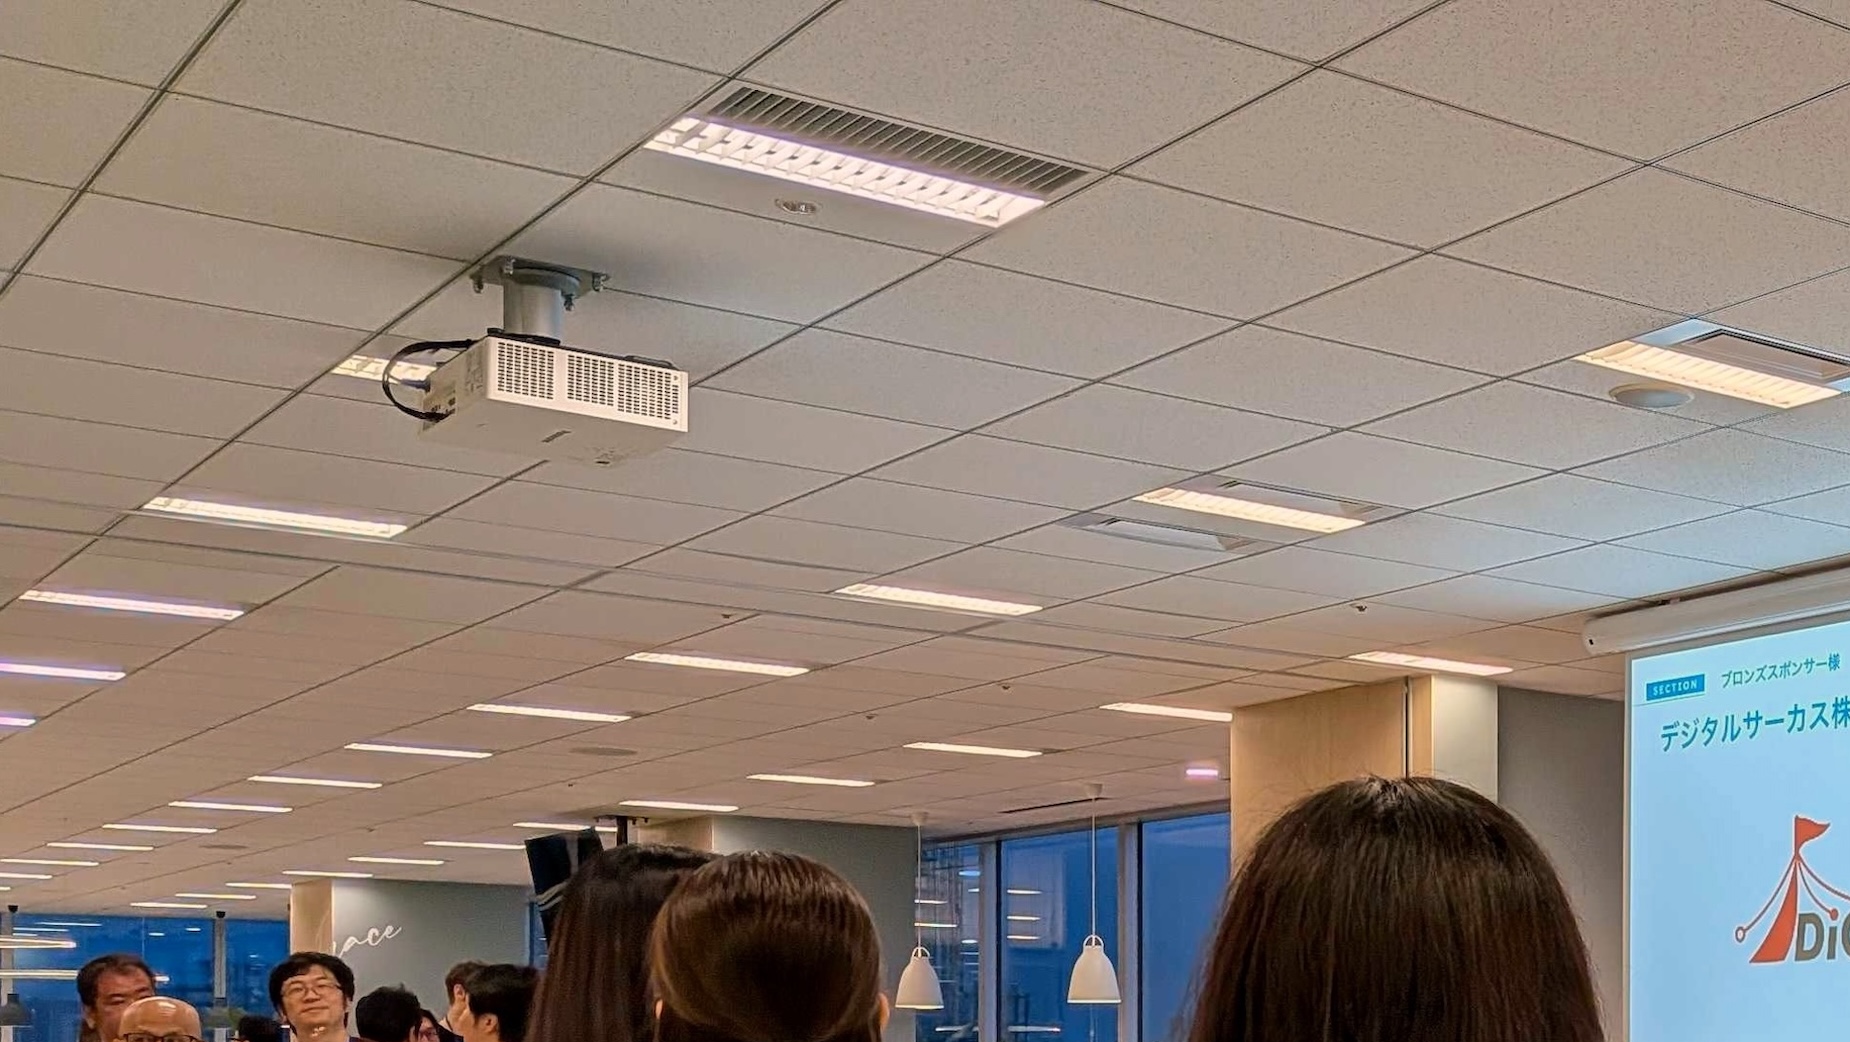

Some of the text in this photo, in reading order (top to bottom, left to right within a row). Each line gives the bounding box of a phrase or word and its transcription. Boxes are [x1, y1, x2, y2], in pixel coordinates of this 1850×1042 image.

[1721, 652, 1841, 689] ブロンズスポンサー様
[1652, 679, 1698, 697] SECTION
